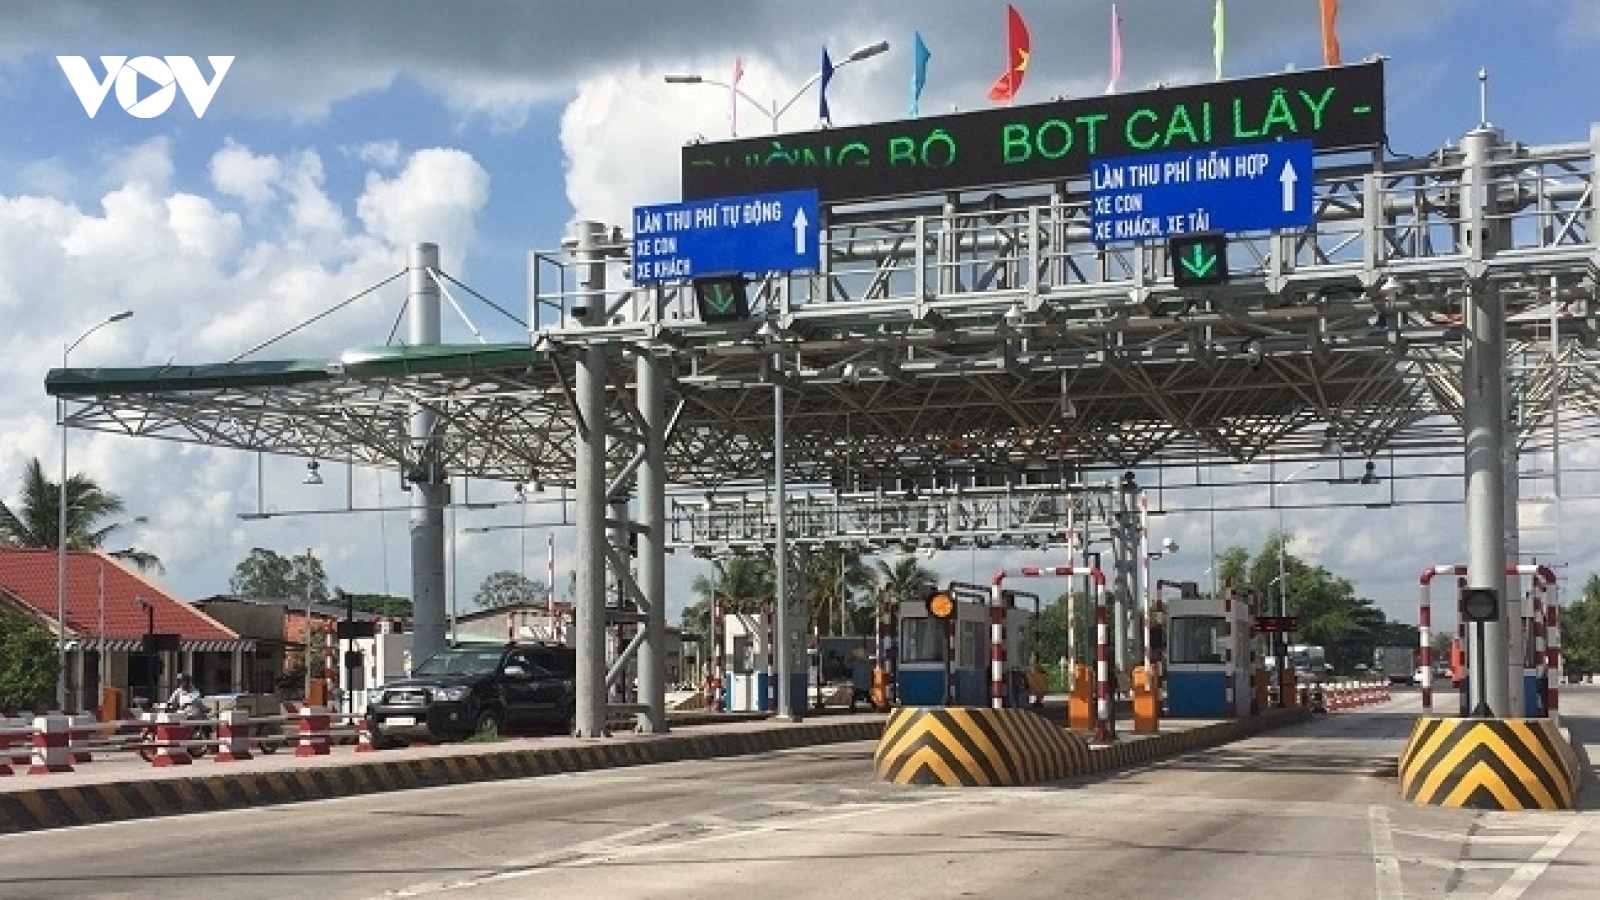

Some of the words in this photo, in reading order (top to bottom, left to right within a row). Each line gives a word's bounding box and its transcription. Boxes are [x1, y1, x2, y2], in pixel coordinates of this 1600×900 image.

[1003, 114, 1108, 165] BOT
[1124, 102, 1212, 150] CAI
[1233, 86, 1335, 142] LẬY
[1093, 163, 1124, 190] LÀN
[1129, 164, 1160, 187] THU
[1164, 156, 1192, 184] PHÍ
[1196, 151, 1229, 181] HỖN
[1235, 153, 1269, 180] HỢP
[1094, 196, 1112, 214] XE
[1115, 193, 1142, 214] CON
[636, 210, 662, 234] LÀN
[664, 210, 692, 231] THU
[695, 202, 720, 229] PHÍ
[720, 204, 742, 229] TỰ
[743, 199, 782, 226] ĐỘNG
[1094, 220, 1112, 240] XE
[1166, 215, 1185, 233] XE
[636, 239, 651, 256] XE
[654, 237, 678, 255] CON
[636, 261, 651, 279] XE
[654, 257, 691, 278] KHÁCH
